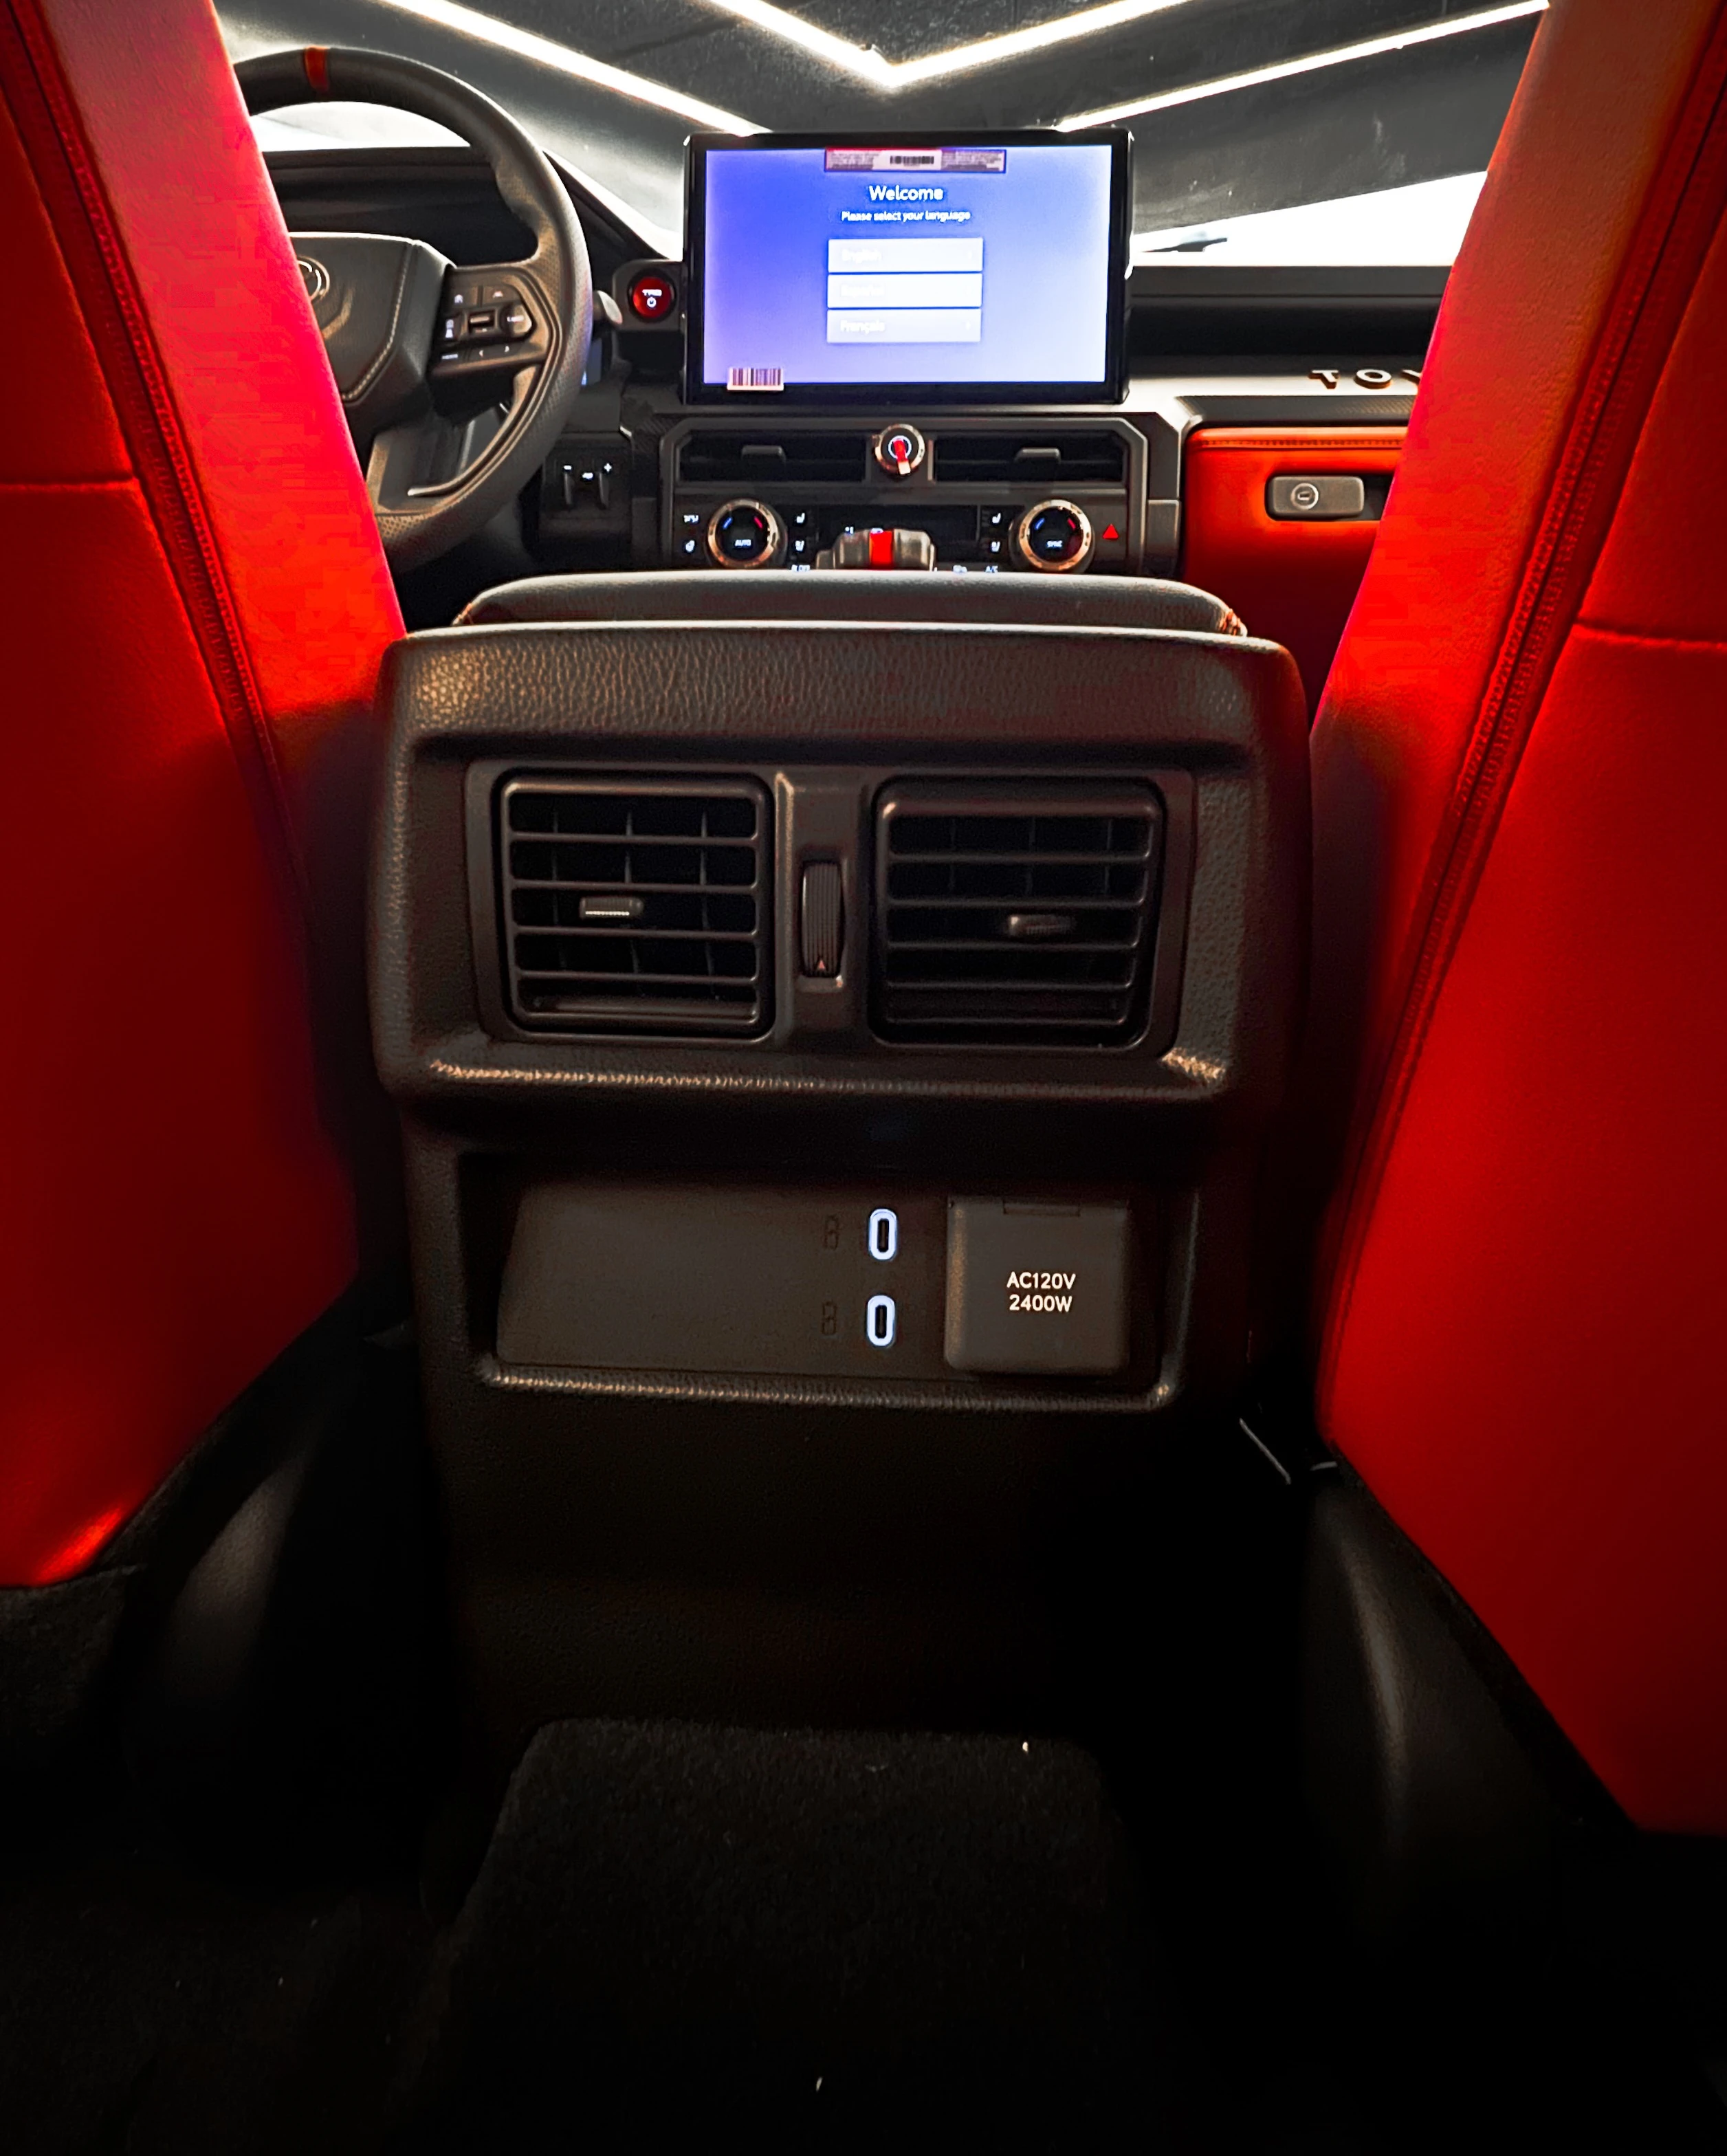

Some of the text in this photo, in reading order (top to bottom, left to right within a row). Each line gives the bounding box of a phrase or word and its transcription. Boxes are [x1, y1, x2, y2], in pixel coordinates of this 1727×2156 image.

[868, 184, 944, 201] Welcome
[841, 210, 971, 223] Please select your language
[1006, 1270, 1077, 1290] AC120V
[1009, 1293, 1073, 1312] 2400W
